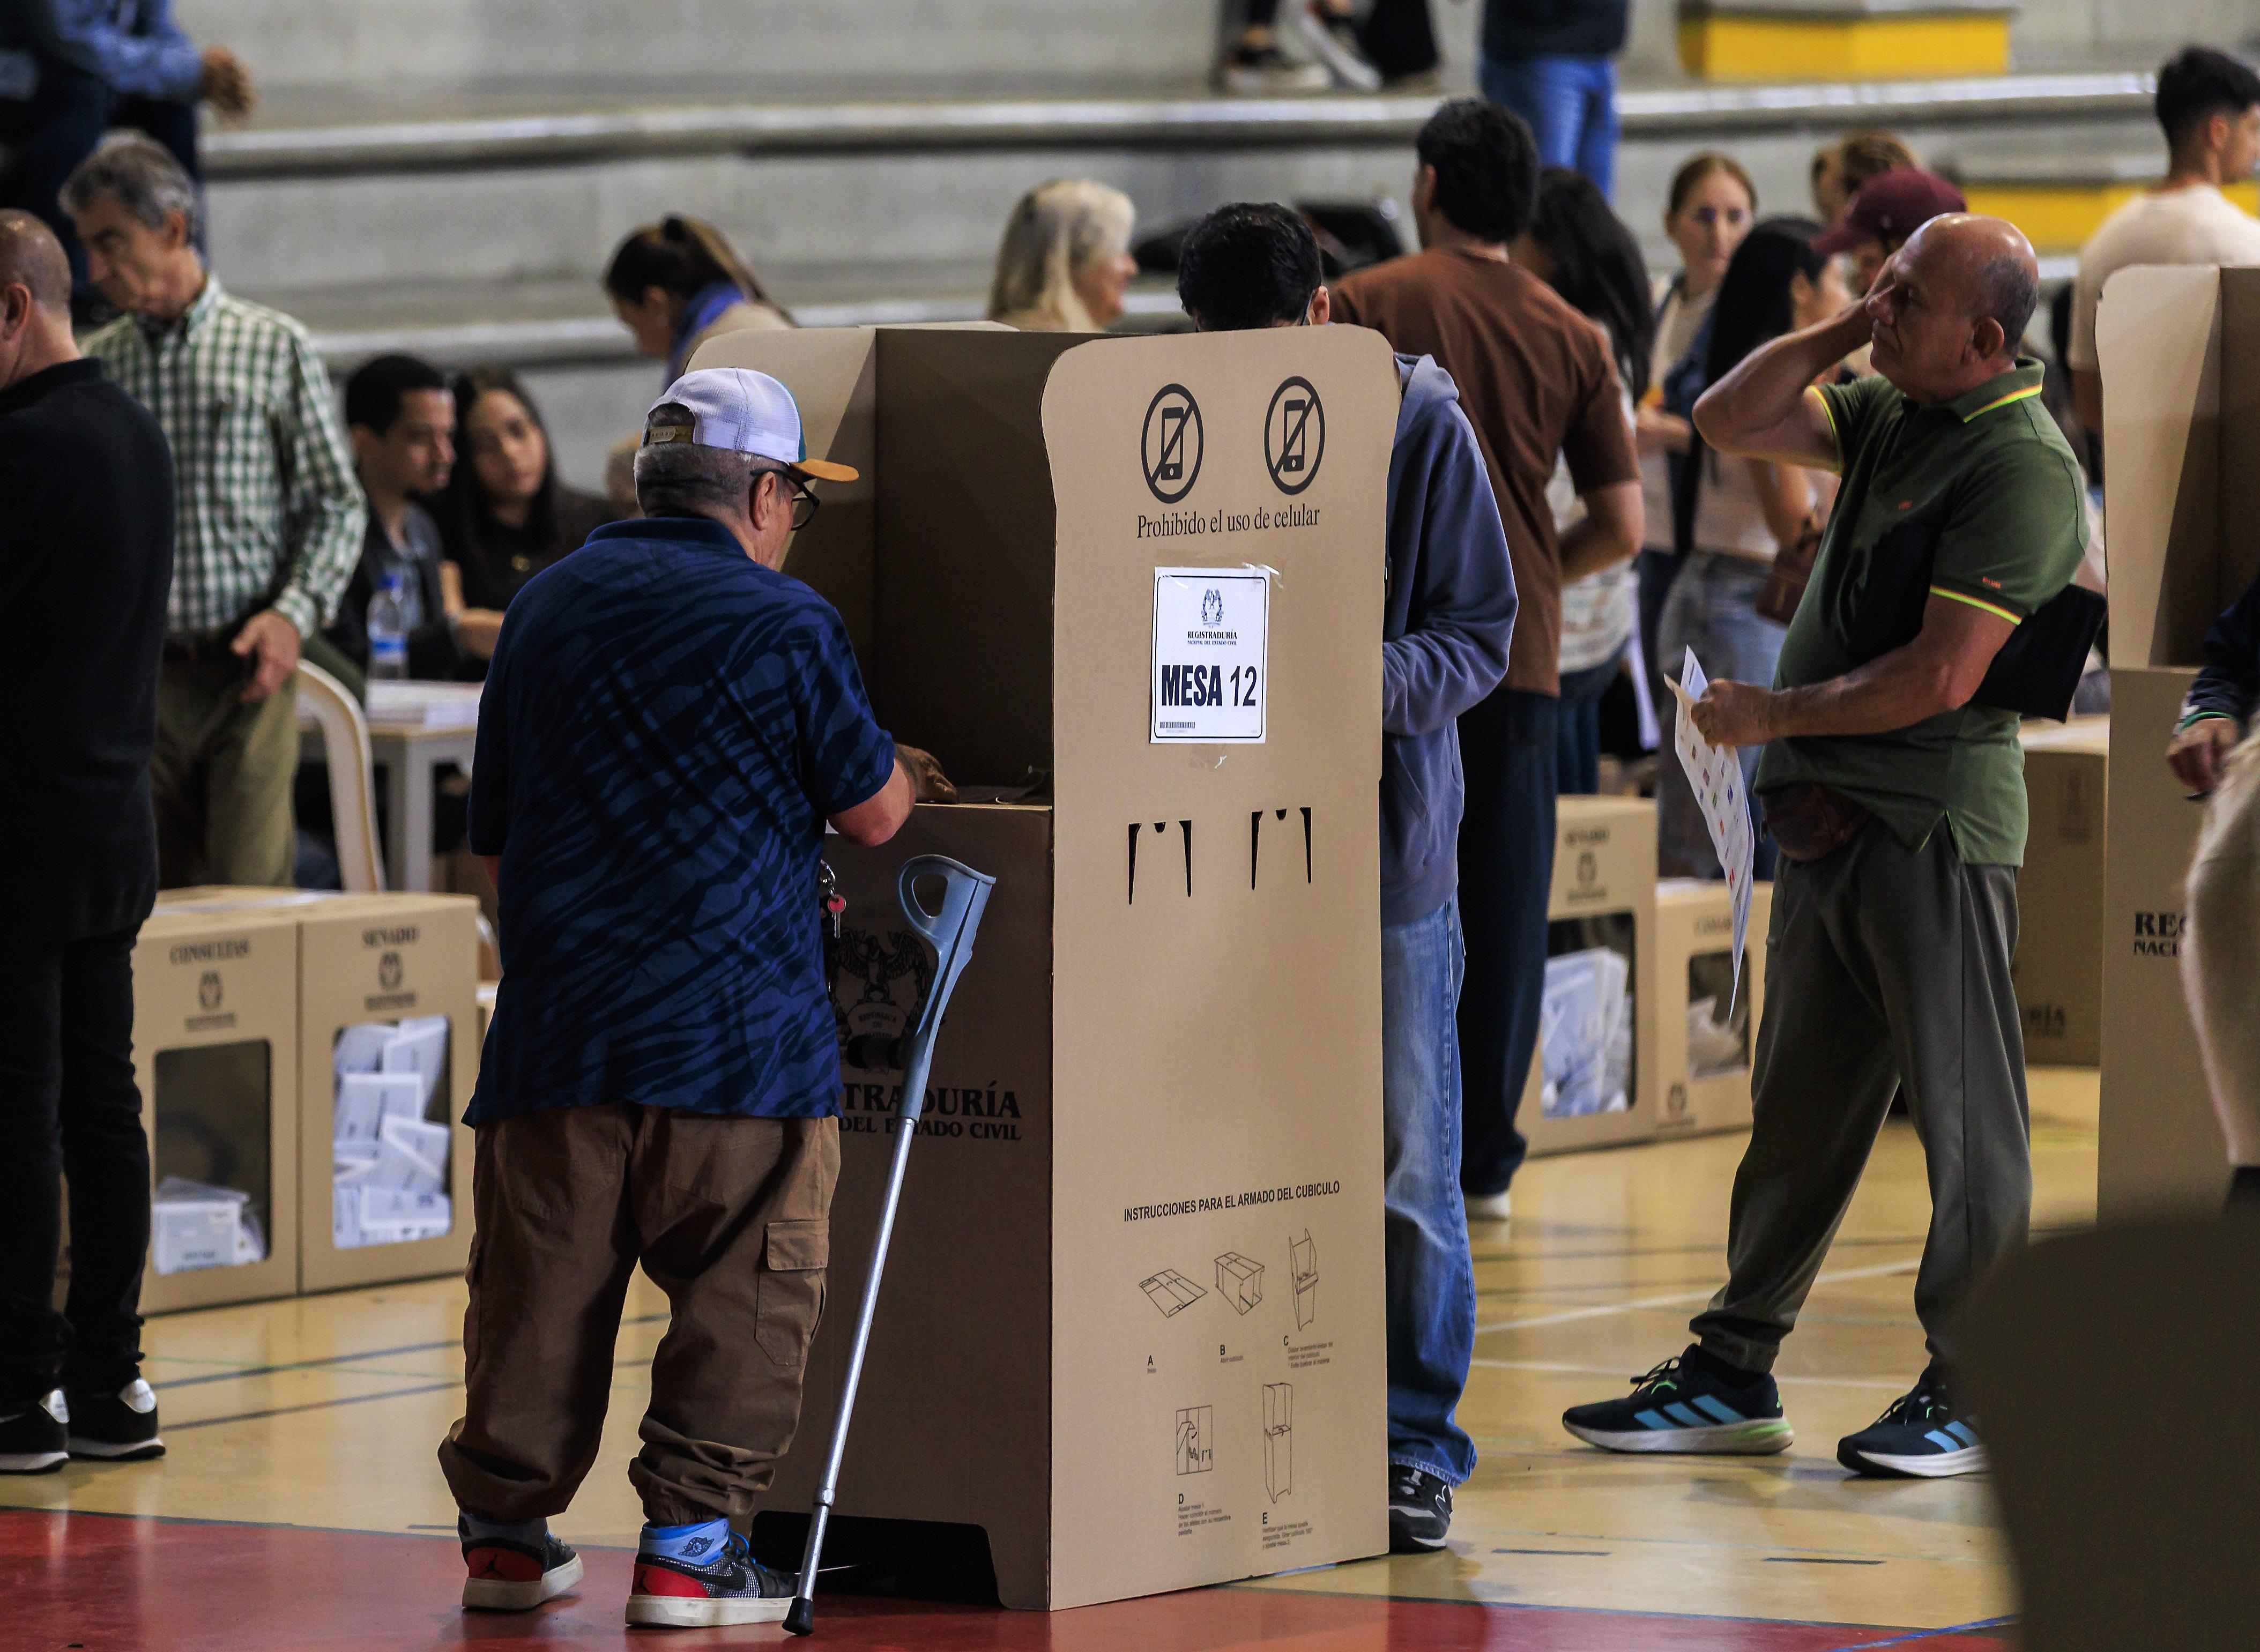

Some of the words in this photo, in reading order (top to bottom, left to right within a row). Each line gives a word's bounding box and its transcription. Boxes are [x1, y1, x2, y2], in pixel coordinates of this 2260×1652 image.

[1137, 511, 1206, 538] Prohibido
[1210, 510, 1222, 532] el
[1228, 513, 1250, 531] uso
[1254, 507, 1269, 529] de
[1274, 503, 1320, 527] celular
[1187, 629, 1237, 639] REGISTRADURÍA
[1162, 665, 1223, 706] MESA
[1230, 666, 1257, 706] 12
[2134, 941, 2179, 956] NACI
[839, 1116, 877, 1133] DEL
[886, 1118, 963, 1137] ETADO
[970, 1123, 1021, 1140] CIVIL
[1124, 1200, 1196, 1222] INSTRUCCIONES
[1199, 1196, 1223, 1211] PARA
[1225, 1196, 1236, 1208] EL
[1238, 1189, 1275, 1207] ARMADO
[1277, 1187, 1293, 1200] DEL
[1296, 1180, 1340, 1199] CUBICULO
[1284, 1335, 1288, 1346] C
[1220, 1344, 1225, 1356] B
[1148, 1355, 1153, 1366] A
[1179, 1493, 1184, 1504] D
[1262, 1512, 1267, 1524] E
